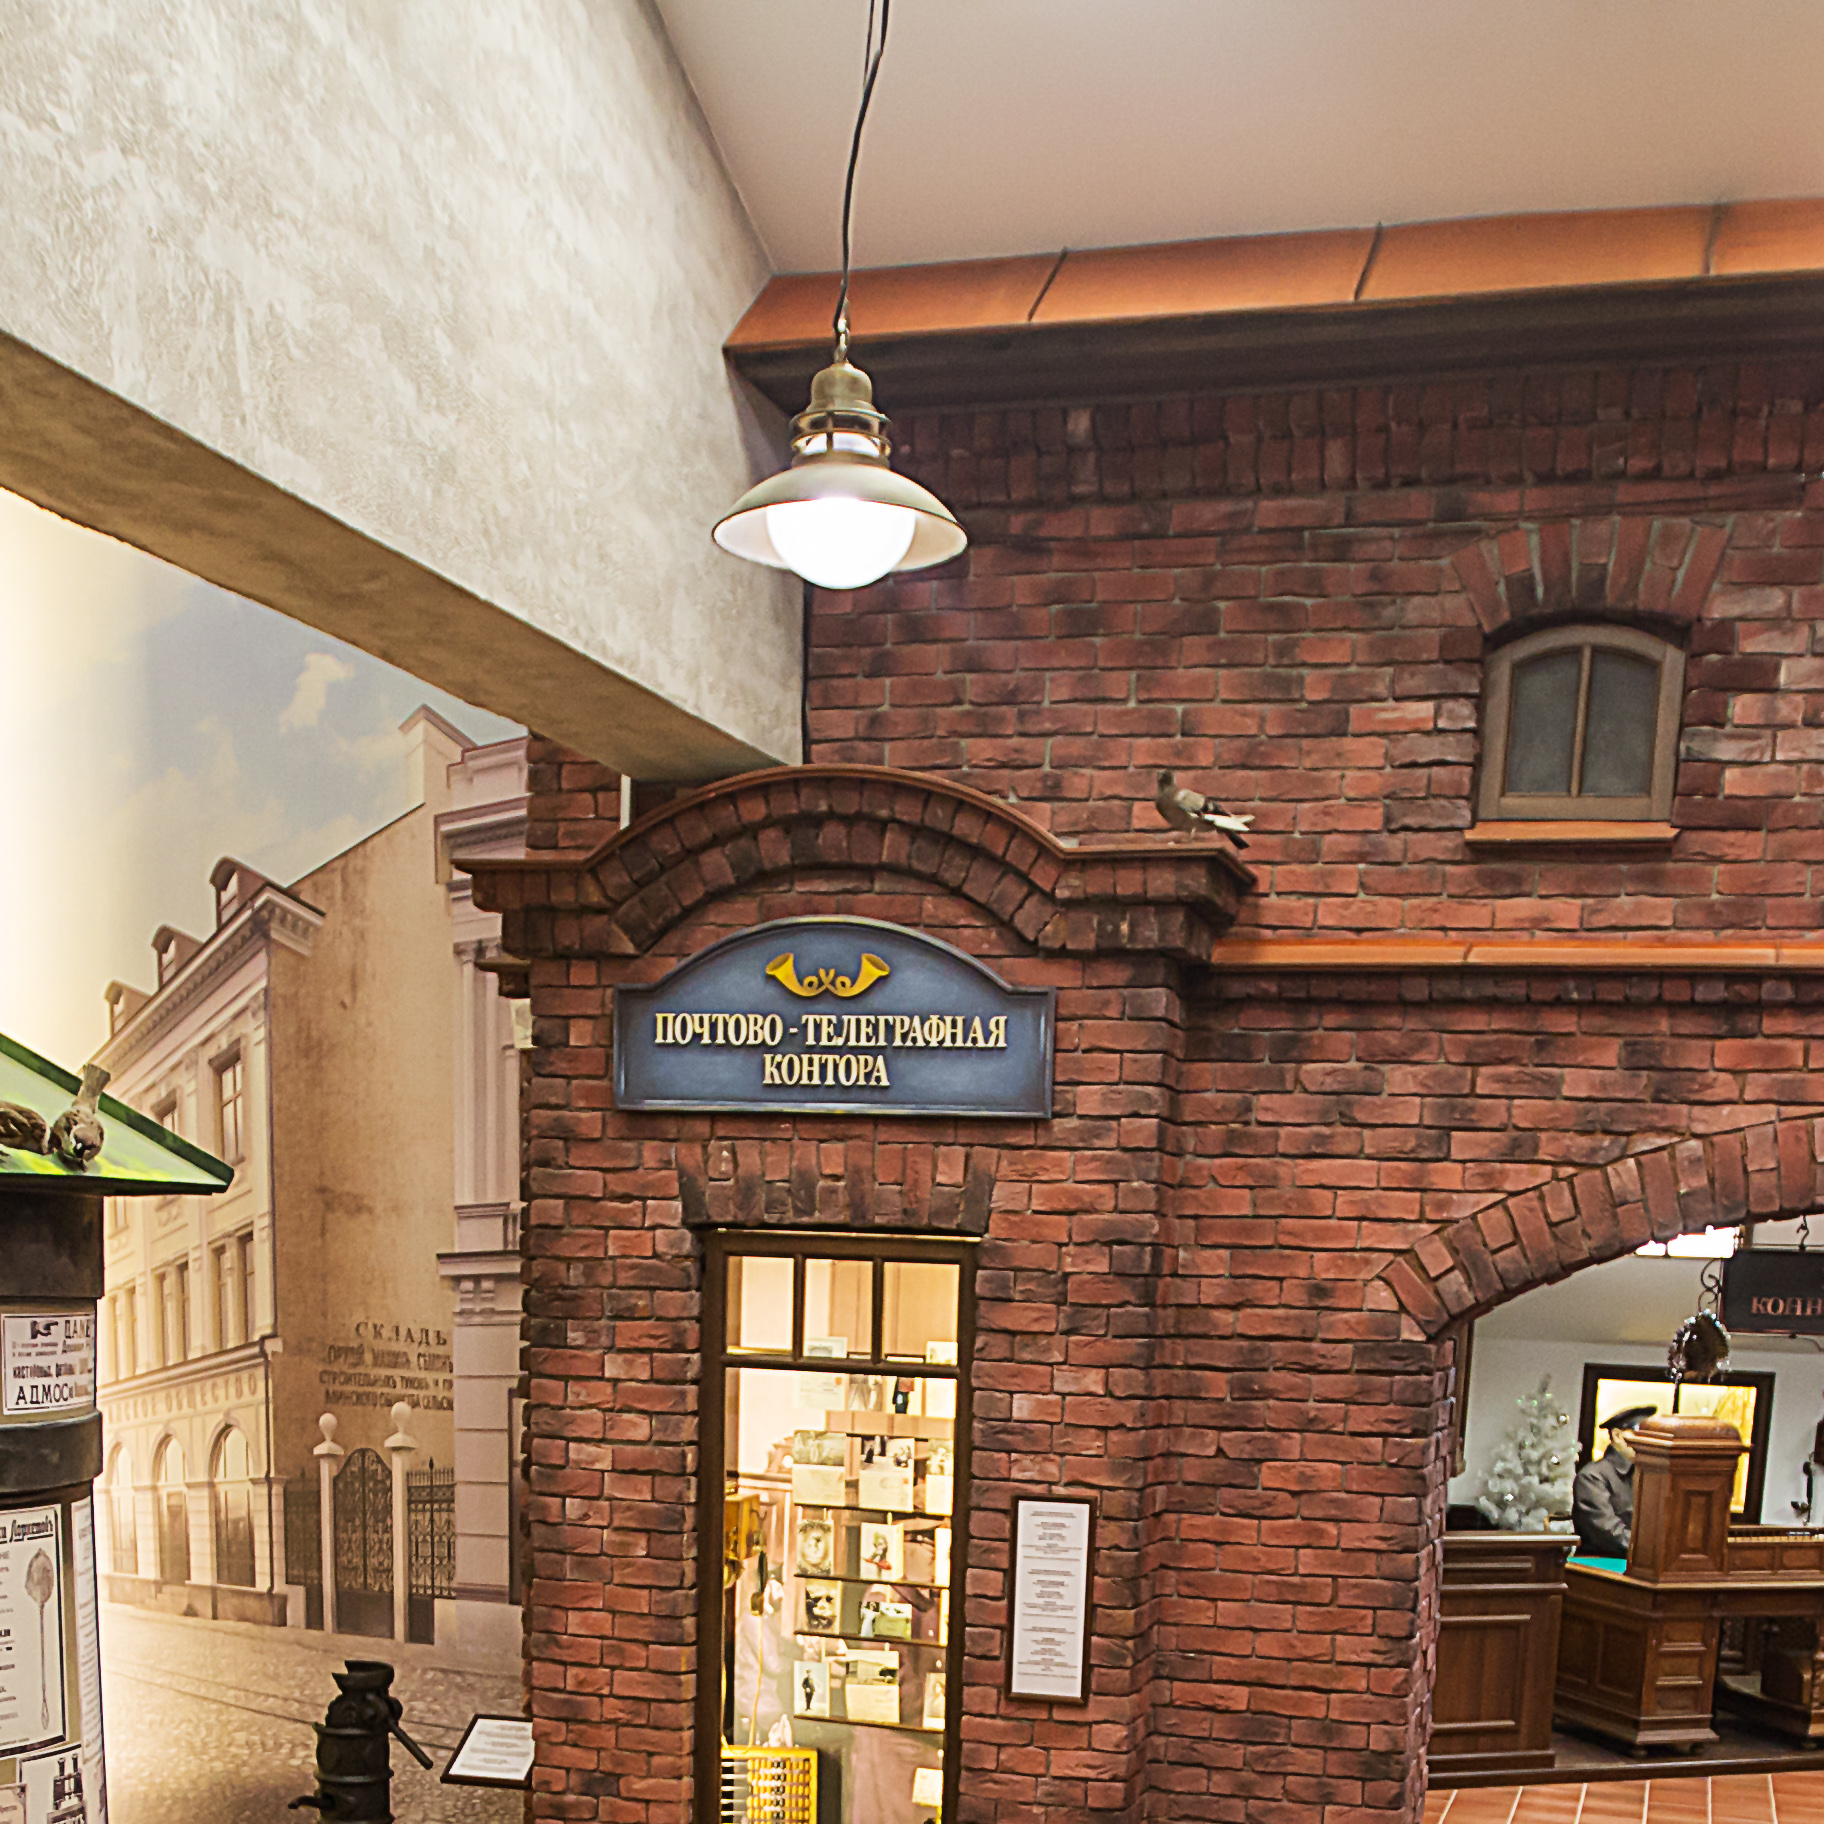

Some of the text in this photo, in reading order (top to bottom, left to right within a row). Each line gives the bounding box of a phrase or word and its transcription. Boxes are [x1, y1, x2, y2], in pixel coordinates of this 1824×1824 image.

[654, 1013, 783, 1046] ПОЧТОВО
[802, 1014, 1008, 1048] ТЕЛЕГРАФНАЯ
[763, 1053, 890, 1087] КОНТОРА
[355, 1321, 447, 1346] СКЛАДЪ
